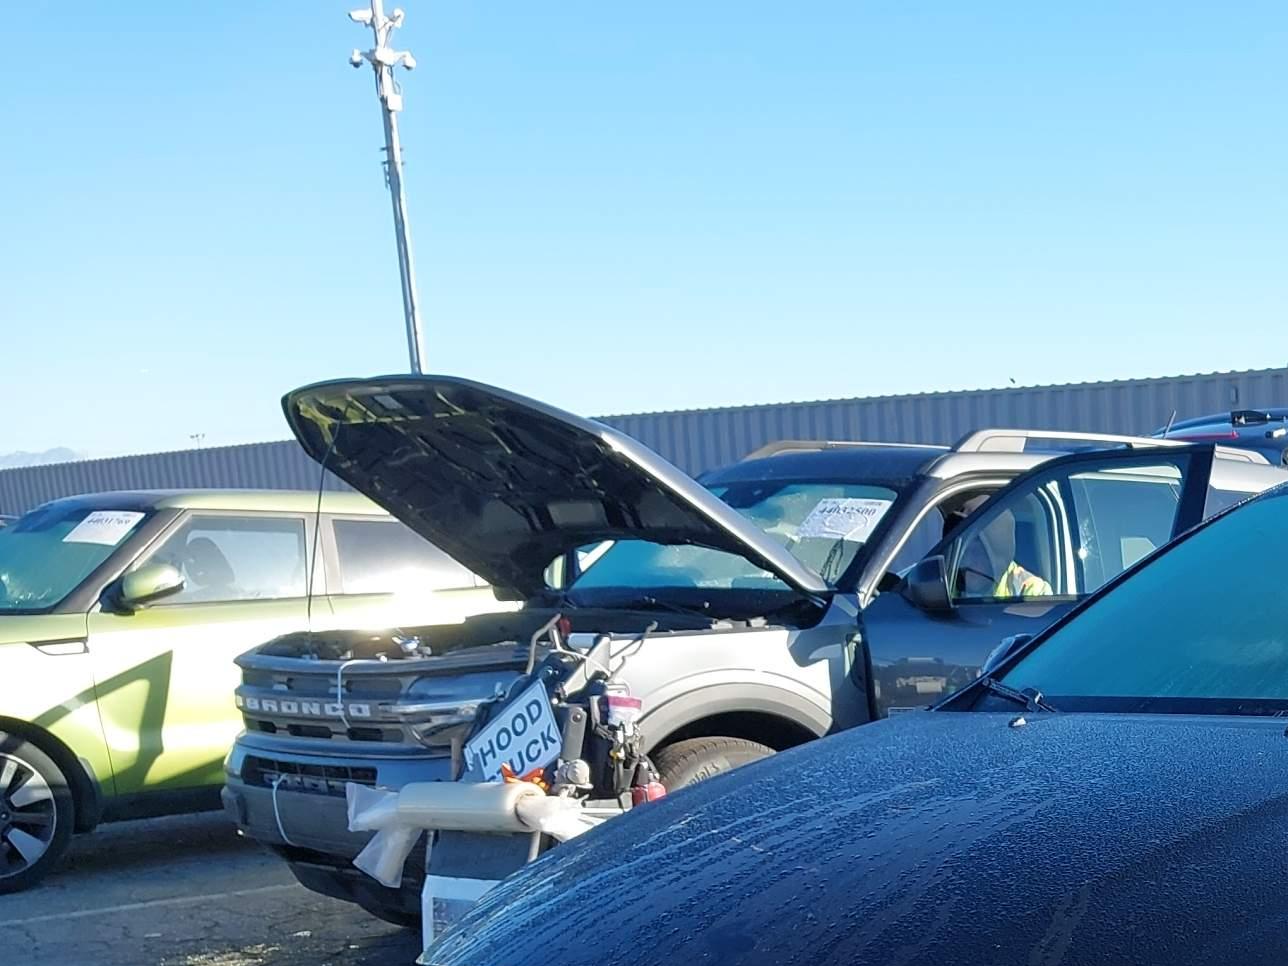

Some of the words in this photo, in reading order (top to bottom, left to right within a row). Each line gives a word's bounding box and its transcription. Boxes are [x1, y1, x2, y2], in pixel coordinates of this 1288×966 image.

[246, 698, 371, 717] BRONCO
[480, 699, 543, 768] HOOD
[487, 723, 557, 782] UCK
